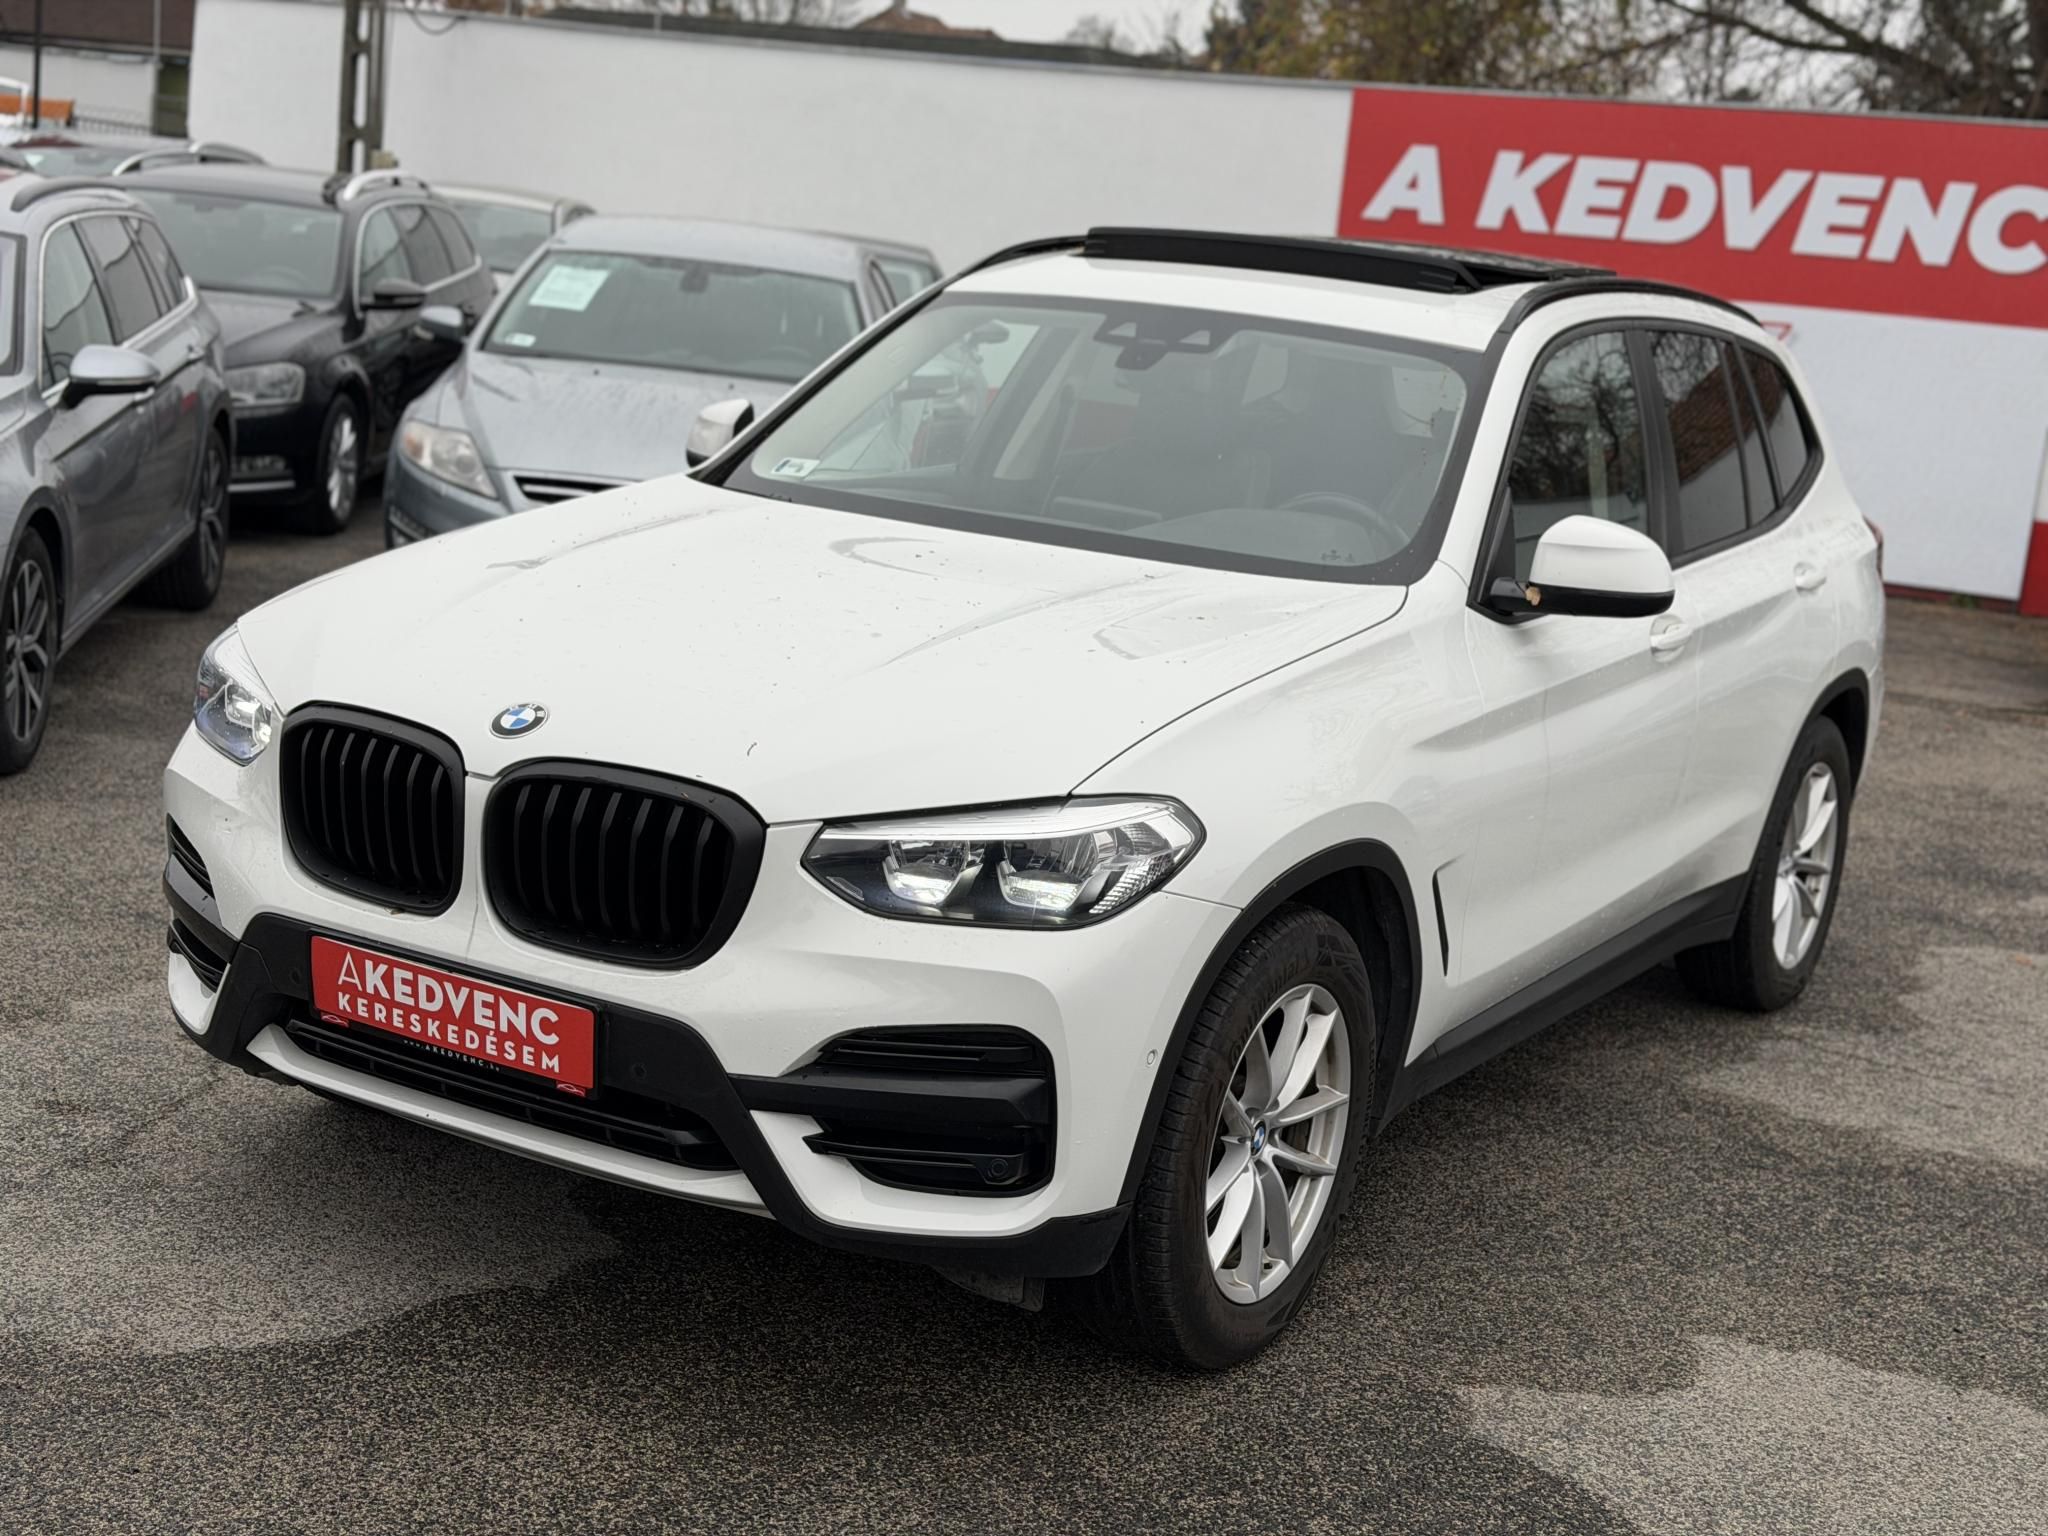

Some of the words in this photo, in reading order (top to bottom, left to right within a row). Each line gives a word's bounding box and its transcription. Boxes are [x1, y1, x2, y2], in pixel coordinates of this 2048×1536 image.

[1361, 144, 1445, 225] A
[1475, 149, 2048, 274] KEDVENC
[338, 991, 560, 1073] KERESKEDÉSEM
